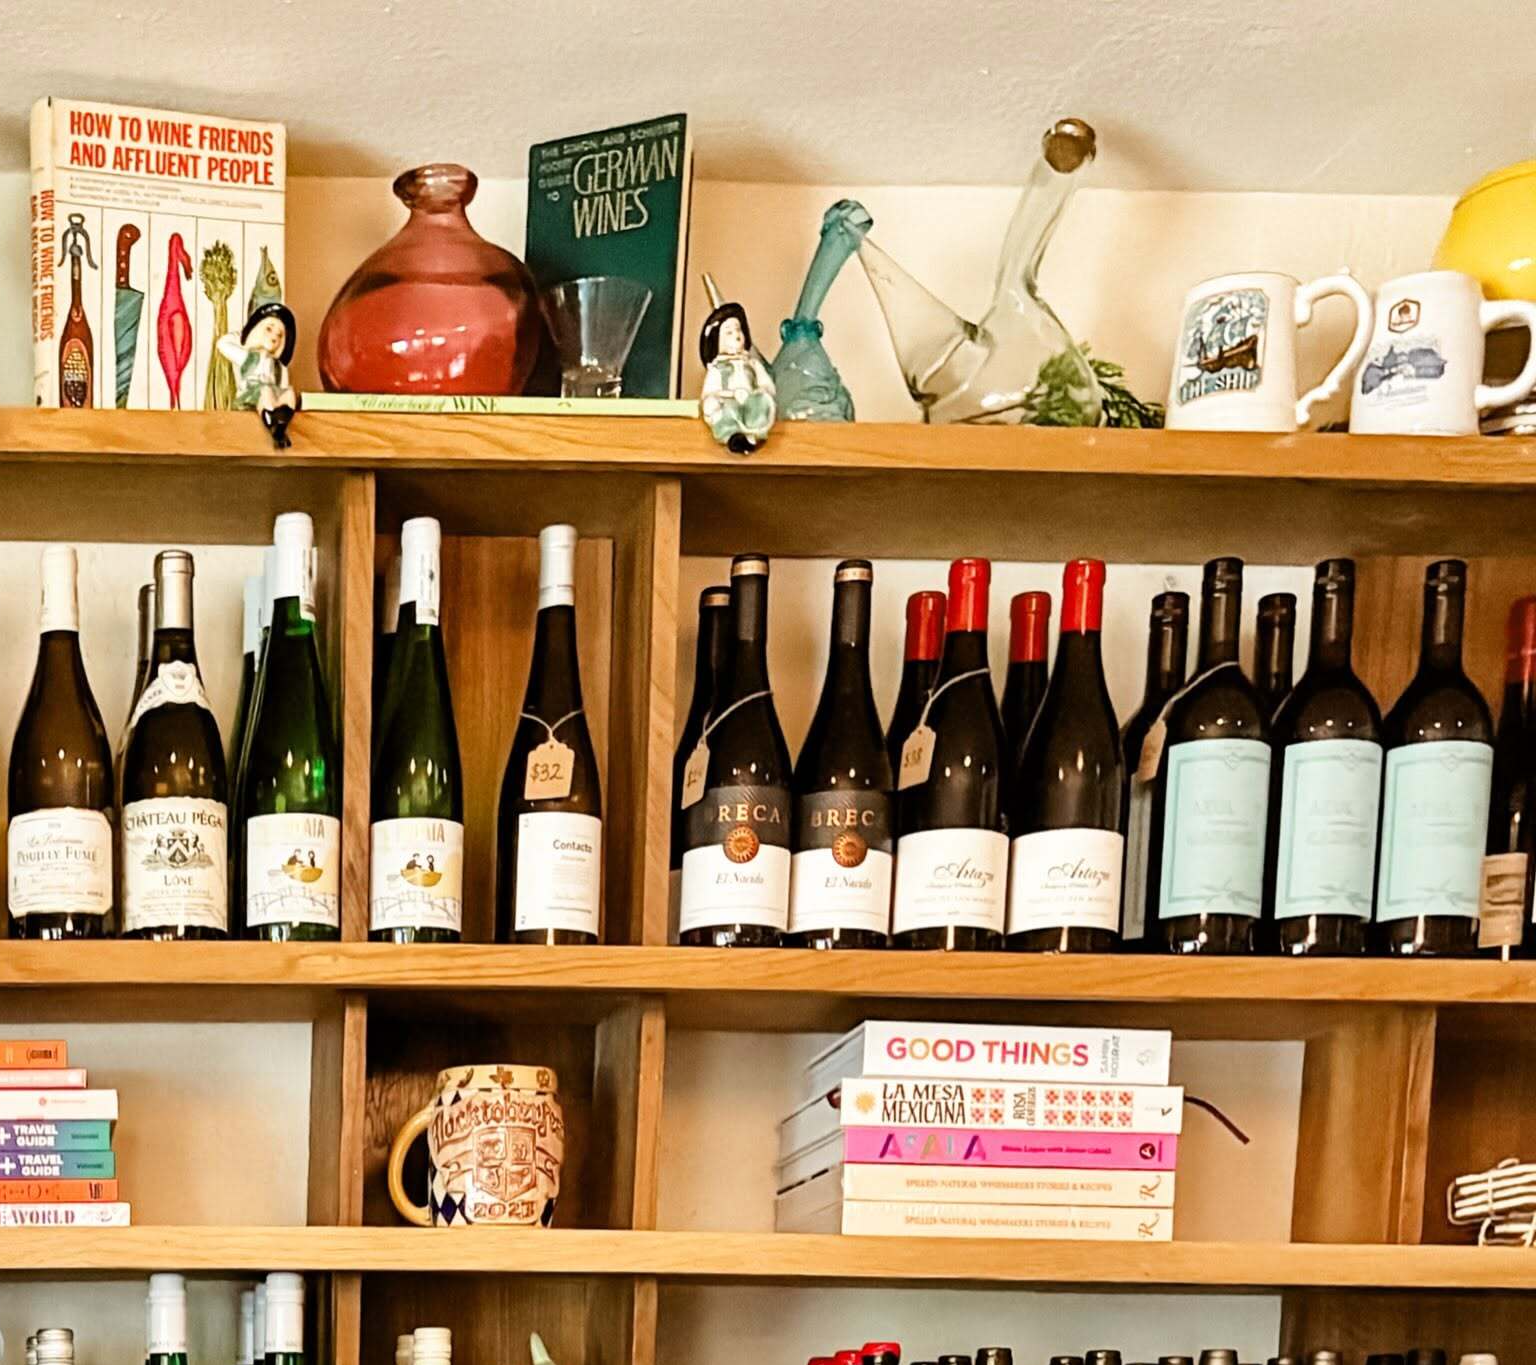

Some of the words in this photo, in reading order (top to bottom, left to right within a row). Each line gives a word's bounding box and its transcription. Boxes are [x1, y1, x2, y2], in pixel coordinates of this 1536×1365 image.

[70, 110, 112, 139] HOW
[118, 115, 141, 143] TO
[147, 119, 193, 149] WINE
[198, 125, 274, 157] FRIENDS
[70, 141, 107, 169] AND
[112, 146, 202, 181] AFFLUENT
[207, 159, 274, 186] PEOPLE
[573, 135, 679, 195] GERMAN
[573, 186, 649, 239] WINES
[529, 763, 564, 783] $32
[886, 1036, 976, 1063] GOOD
[982, 1039, 1090, 1068] THINGS
[881, 1084, 904, 1101] LA
[911, 1084, 965, 1101] MESA
[881, 1100, 967, 1125] MEXICANA
[12, 1123, 59, 1136] TRAVEL
[15, 1135, 57, 1148] GUIDE
[17, 1153, 65, 1166] TRAVEL
[21, 1164, 62, 1178] GUIDE
